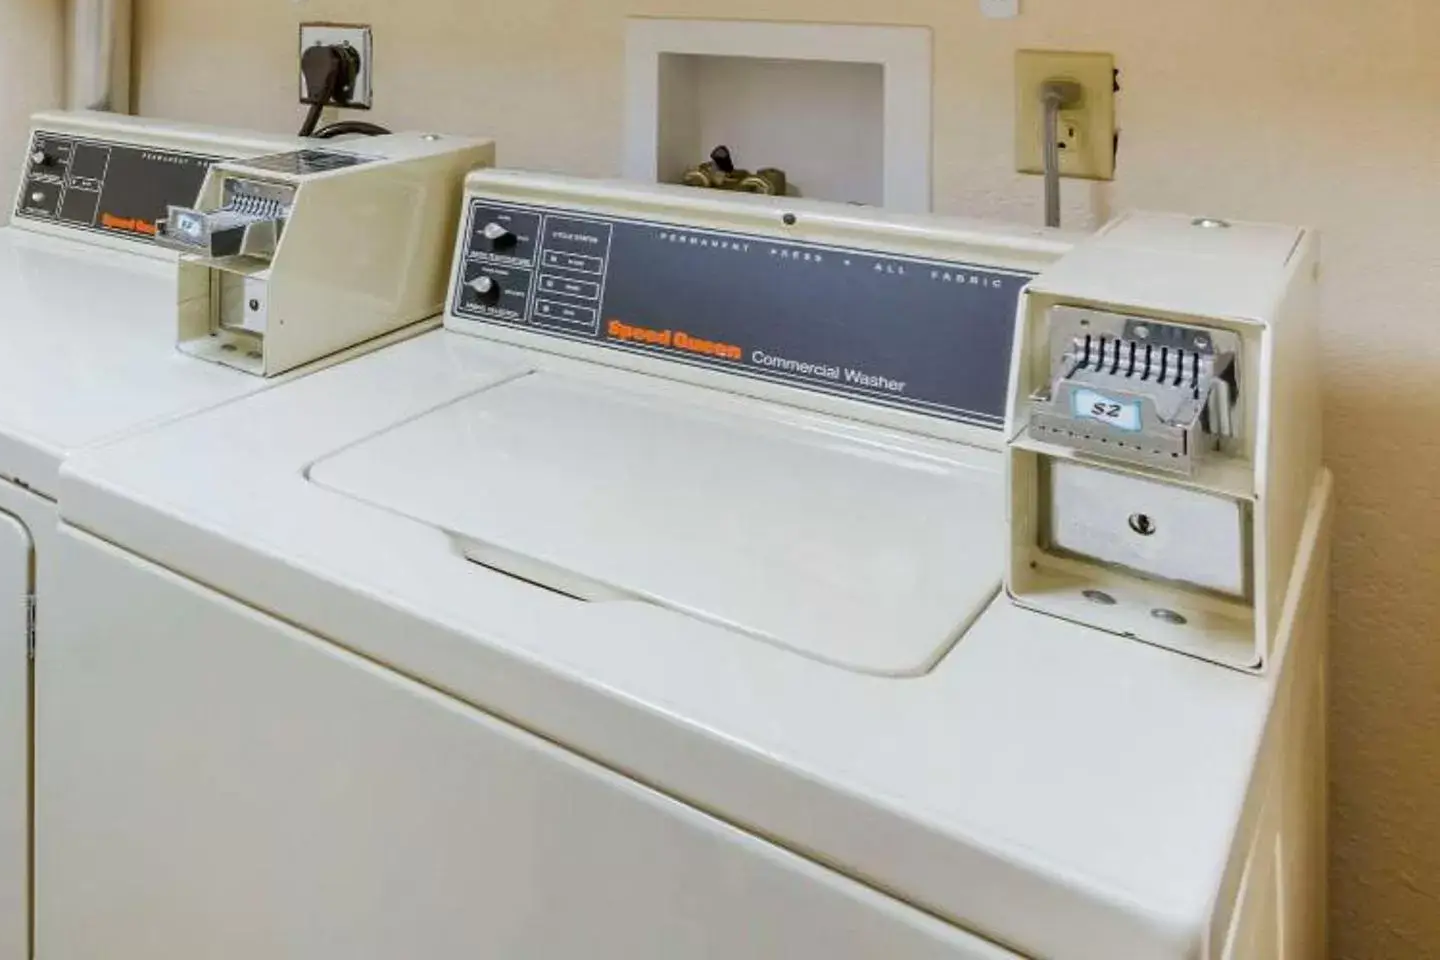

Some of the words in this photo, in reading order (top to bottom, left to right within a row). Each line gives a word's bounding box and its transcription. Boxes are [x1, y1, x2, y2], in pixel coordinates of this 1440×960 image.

[659, 232, 750, 253] PERMANENT
[873, 262, 905, 275] ALL
[930, 270, 1002, 288] FABRIC
[607, 319, 672, 347] Speed
[673, 331, 742, 361] Queen
[751, 349, 841, 380] Commercial
[843, 367, 908, 392] Washer
